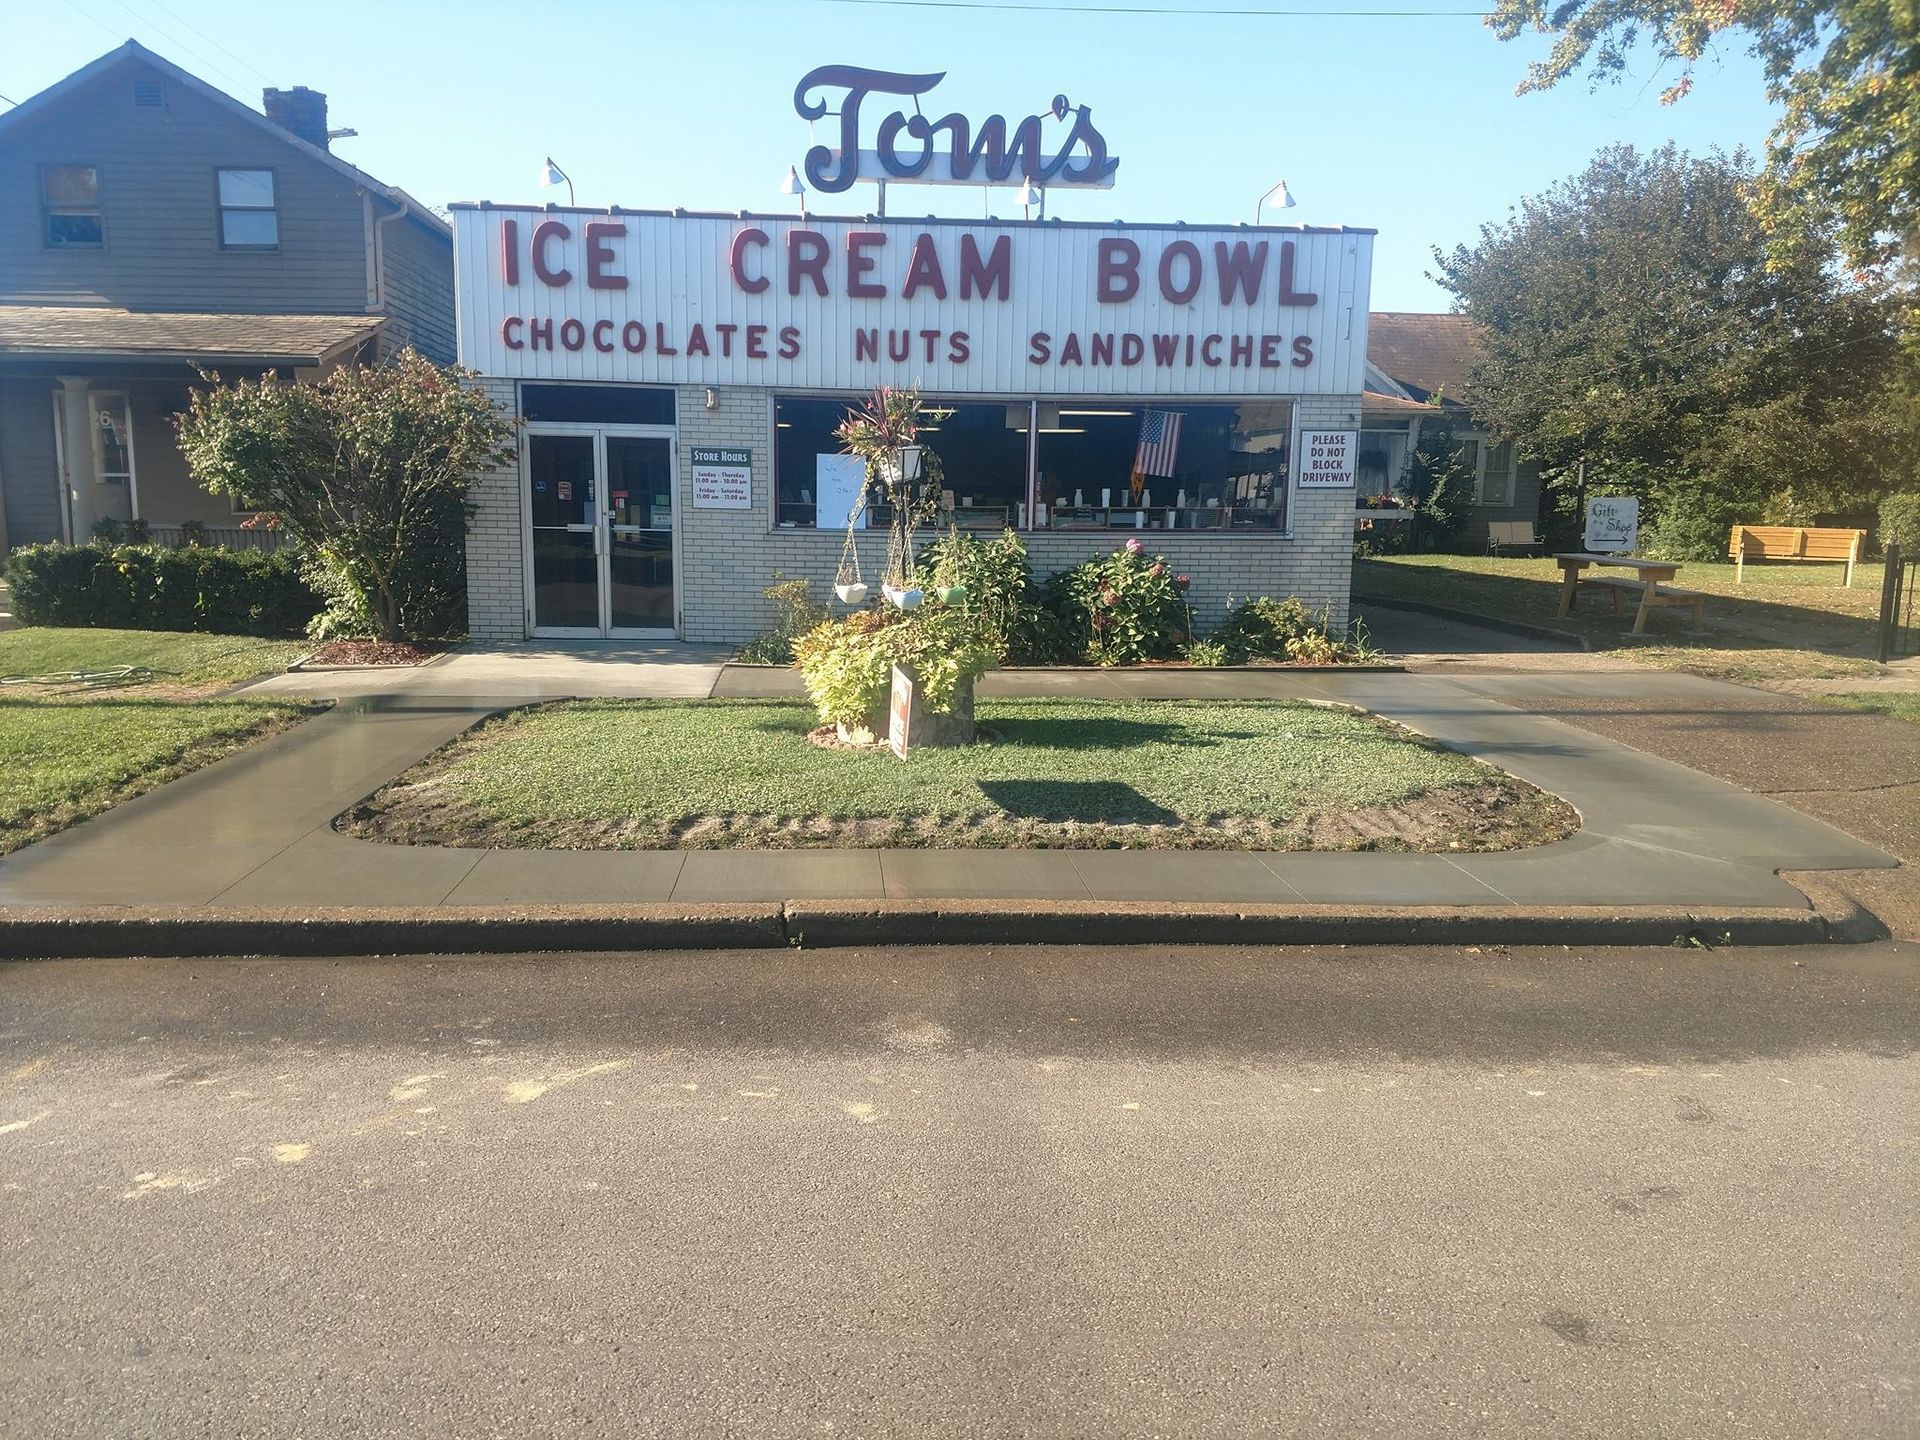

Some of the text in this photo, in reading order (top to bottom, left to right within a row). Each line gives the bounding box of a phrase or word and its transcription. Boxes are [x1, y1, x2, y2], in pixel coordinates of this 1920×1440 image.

[794, 64, 1120, 193] Tom's
[501, 219, 1318, 306] ICE CREAM BOWL
[502, 316, 1313, 368] CHOCOLATES NUTS SANDWICHES
[1312, 435, 1346, 445] PLEASE
[694, 450, 748, 462] STORE HOURS
[1310, 447, 1346, 457] DO NOT
[1312, 460, 1343, 470] BLOCK
[1302, 472, 1352, 482] DRIVEWAY
[1592, 503, 1617, 518] Gift
[1606, 517, 1632, 536] Shop
